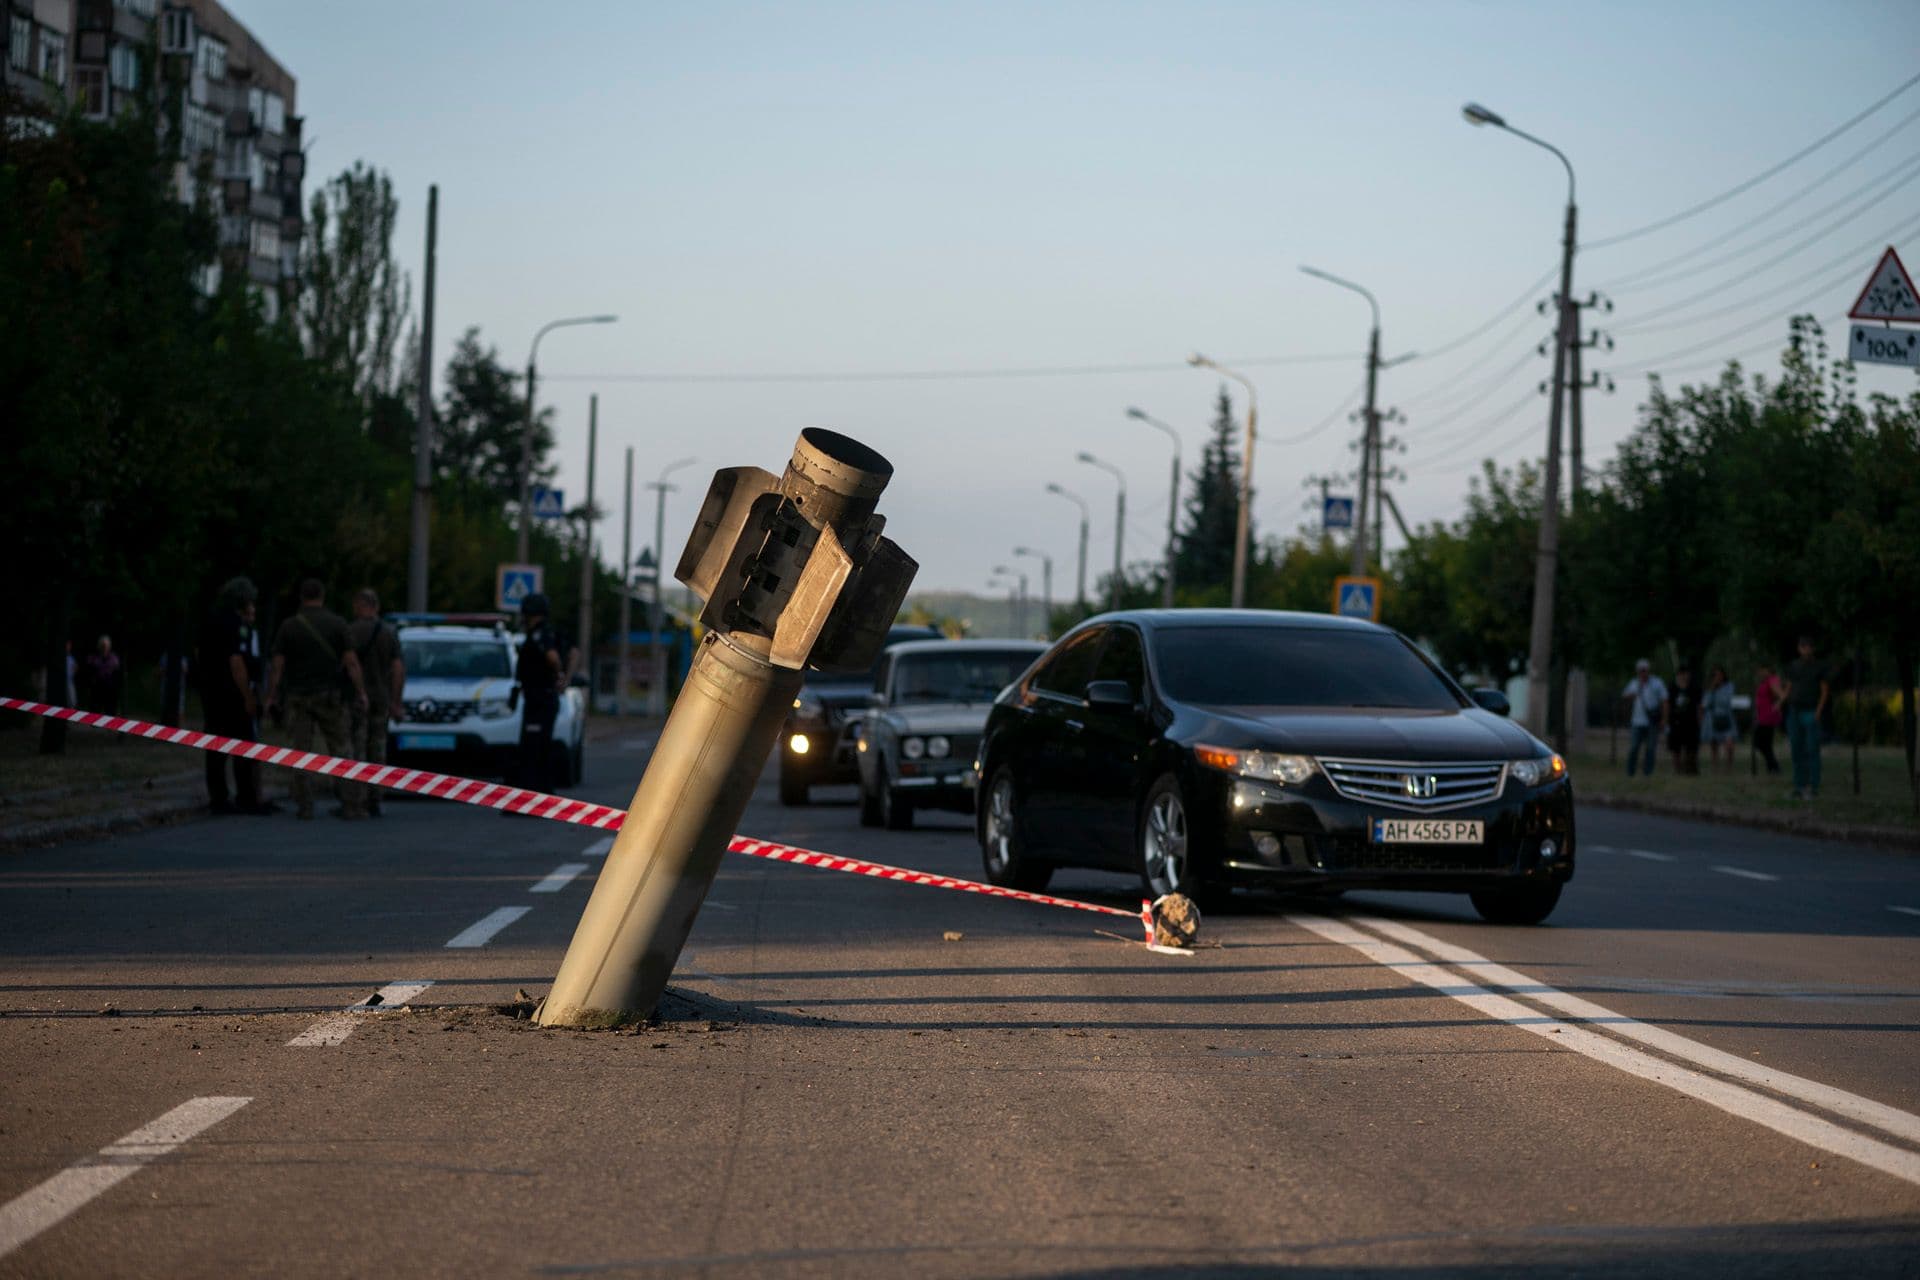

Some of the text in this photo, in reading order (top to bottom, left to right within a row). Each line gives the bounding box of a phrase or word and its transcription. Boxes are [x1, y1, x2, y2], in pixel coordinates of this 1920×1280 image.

[1385, 823, 1409, 840] AH
[1412, 823, 1451, 840] 4565
[1455, 823, 1479, 840] PA
